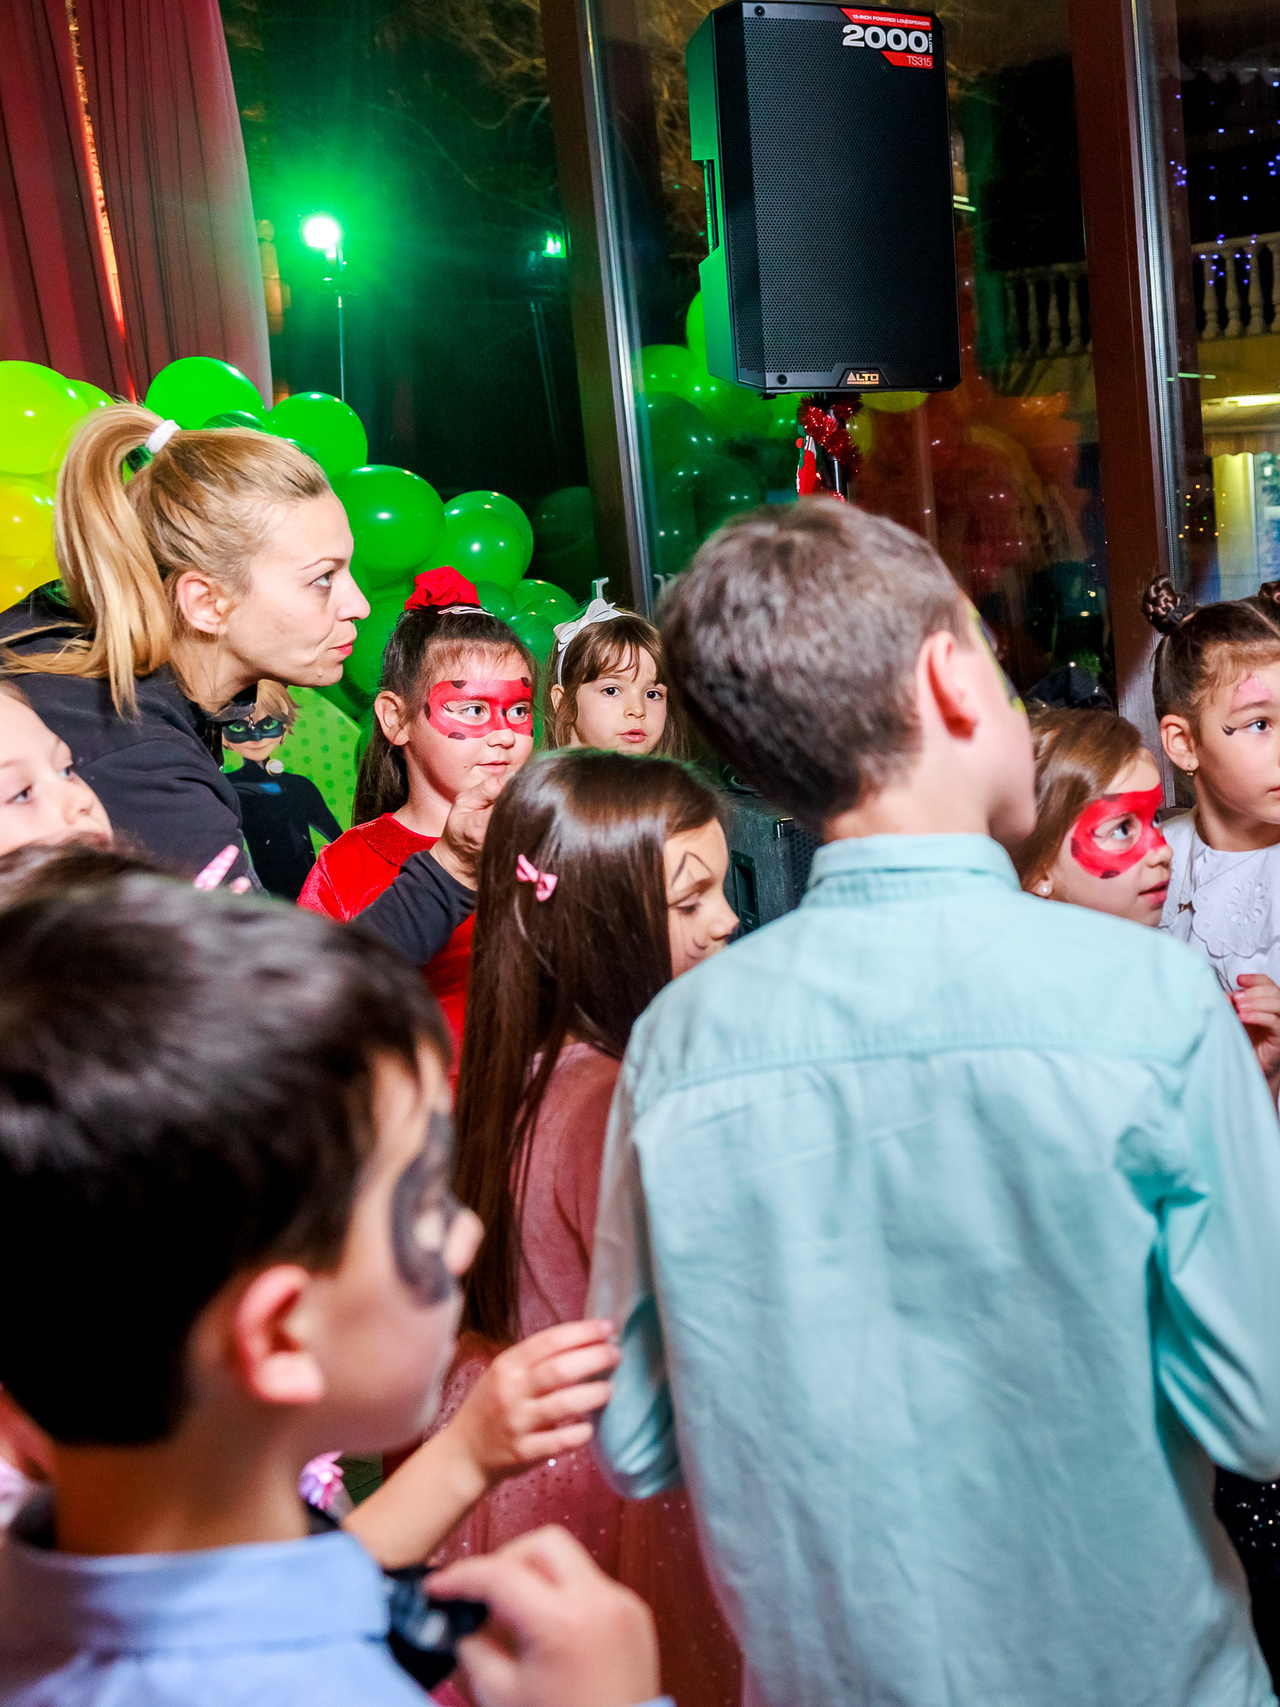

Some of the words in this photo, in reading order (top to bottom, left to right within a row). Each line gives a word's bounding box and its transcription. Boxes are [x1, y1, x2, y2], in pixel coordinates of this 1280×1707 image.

[897, 18, 930, 26] LOUDSPEAKER
[842, 24, 929, 53] 2000
[907, 55, 932, 67] TS315
[847, 372, 879, 381] ALTO
